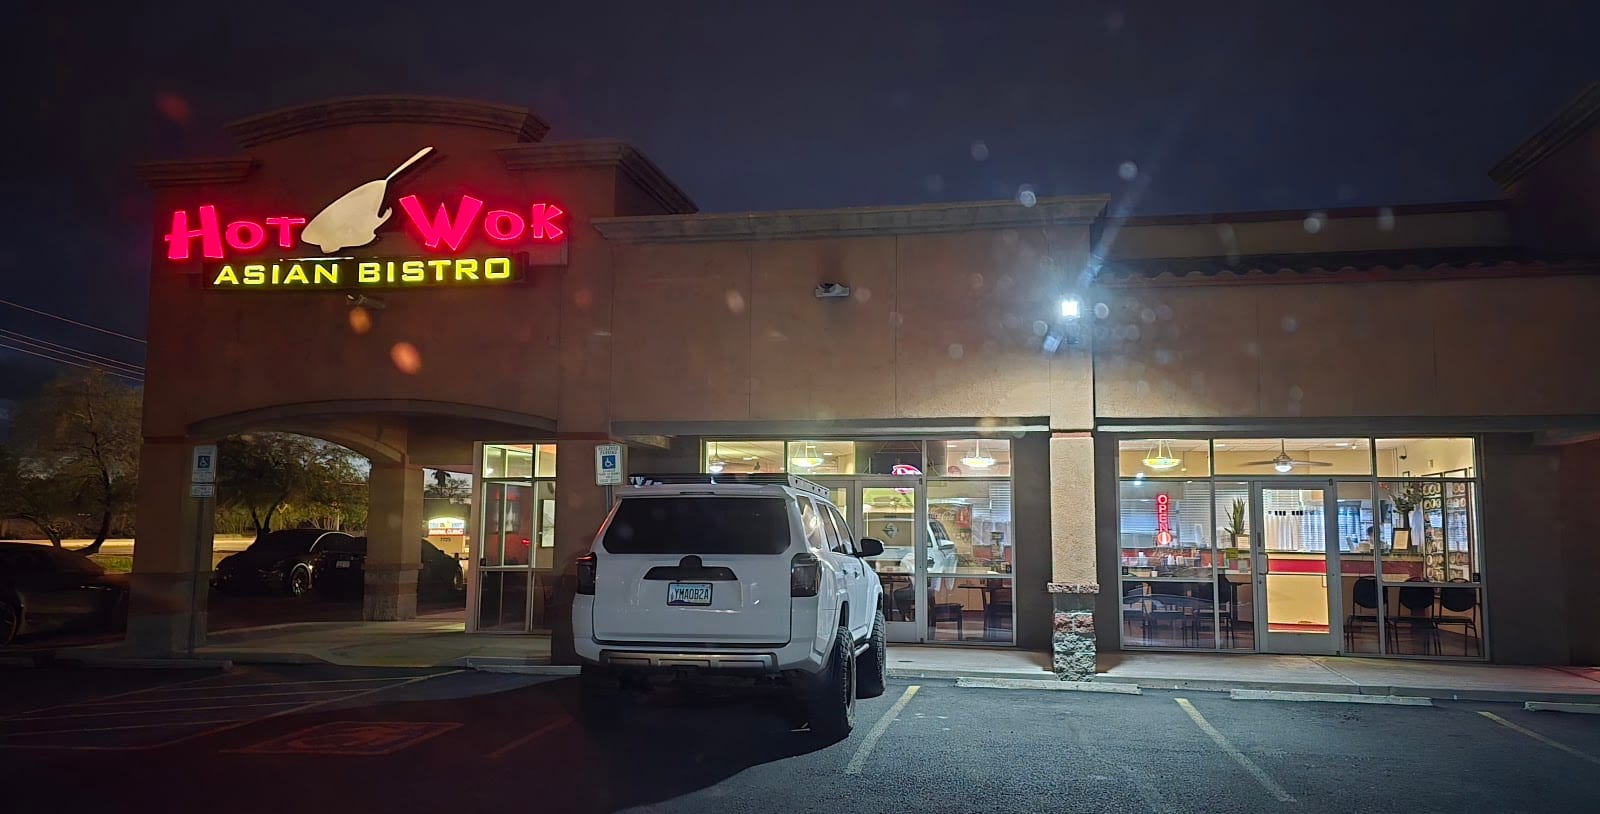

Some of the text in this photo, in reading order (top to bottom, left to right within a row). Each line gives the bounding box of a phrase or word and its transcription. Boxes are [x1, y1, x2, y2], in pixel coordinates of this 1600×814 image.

[213, 257, 511, 286] ASIAN BISTRO
[1157, 494, 1168, 532] OPEN
